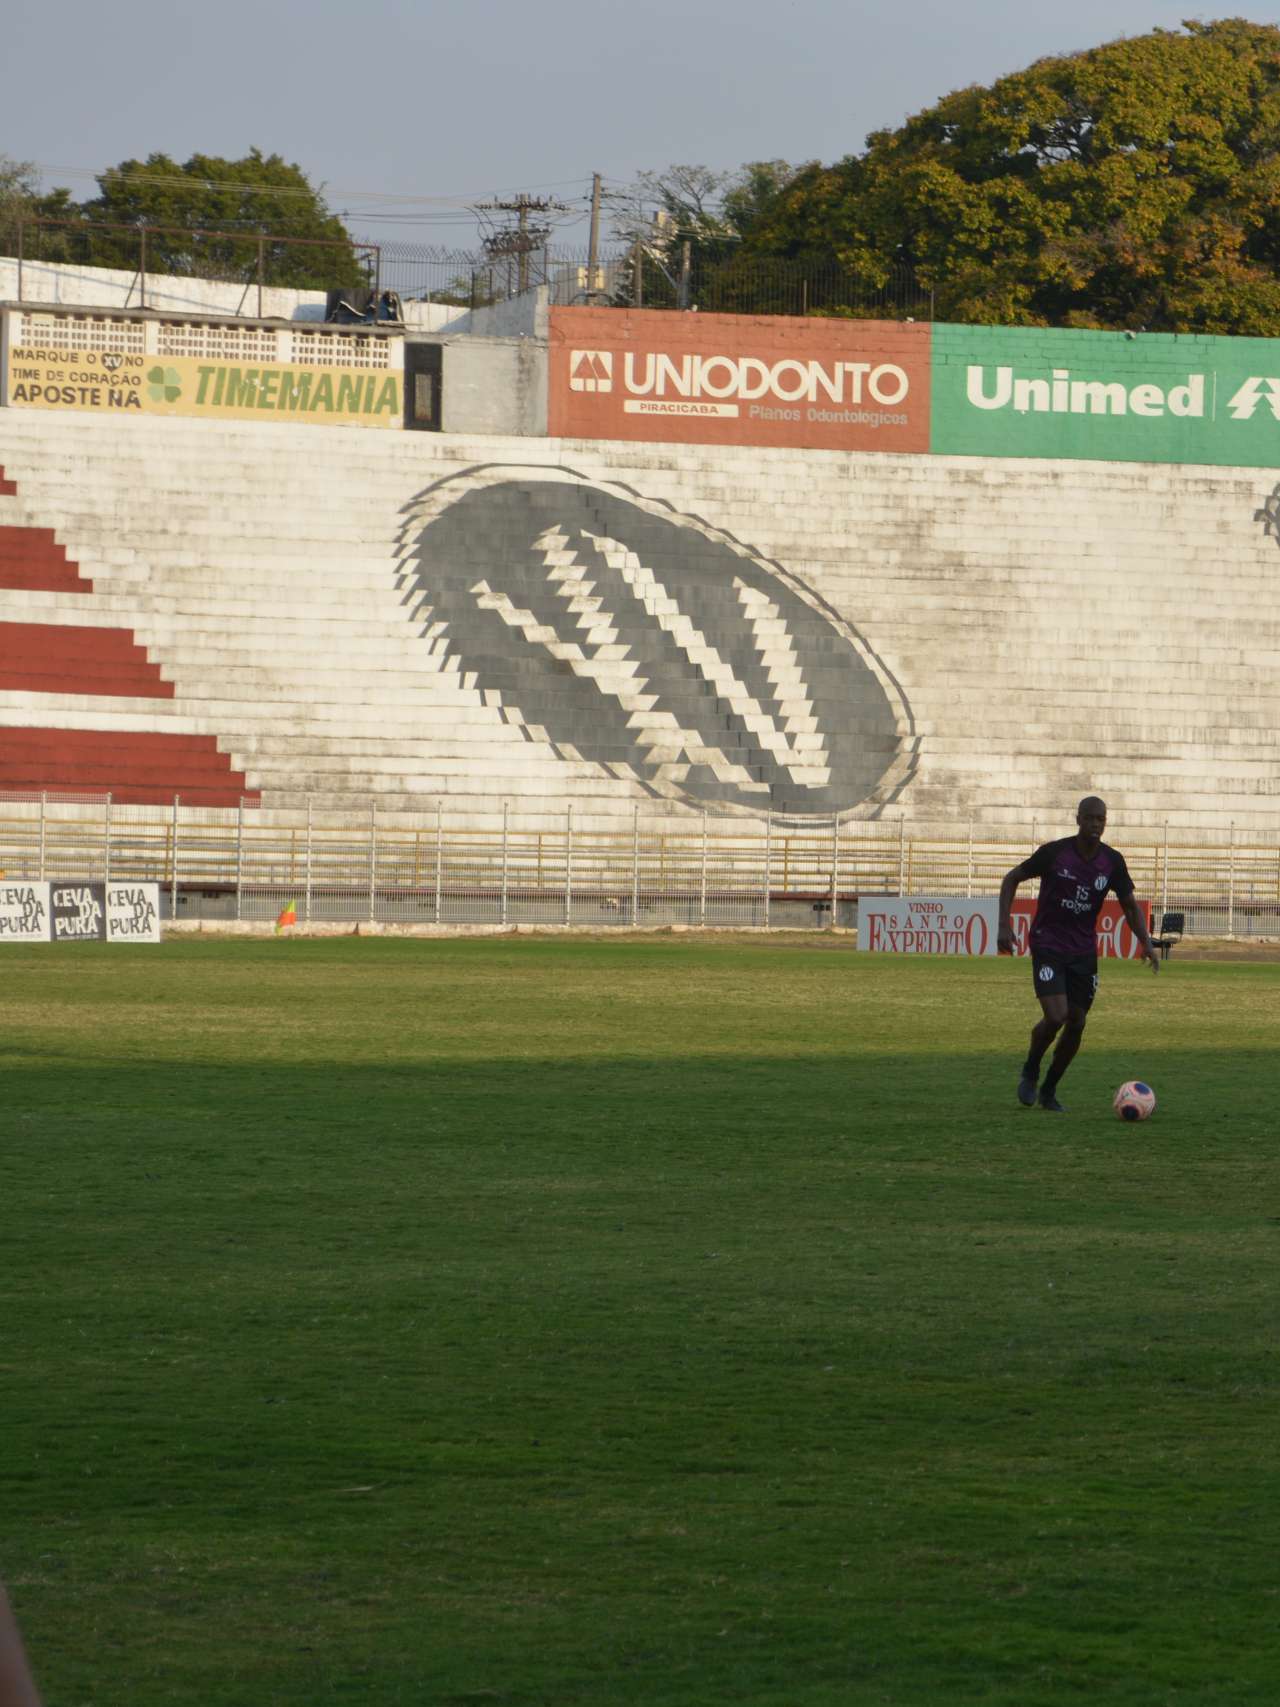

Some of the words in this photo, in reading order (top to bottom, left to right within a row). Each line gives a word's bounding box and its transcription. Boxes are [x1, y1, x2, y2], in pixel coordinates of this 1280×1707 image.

[13, 349, 79, 364] MARQUE
[86, 354, 97, 364] O
[103, 355, 122, 368] XV
[125, 356, 144, 367] NO
[13, 368, 40, 380] TIME
[46, 370, 65, 382] DE
[69, 372, 142, 387] CORAÇÃO
[624, 352, 910, 405] UNIODONTO
[13, 383, 101, 406] APOSTE
[108, 389, 142, 408] NA
[195, 366, 400, 414] TIMEMANIA
[967, 366, 1205, 417] Unimed
[639, 403, 719, 415] PIRACICABA
[749, 405, 801, 422] Planos
[53, 888, 95, 907] CEVA
[108, 889, 147, 907] CEVA
[23, 900, 45, 918] DA
[133, 902, 156, 919] DA
[909, 903, 944, 913] VINHO
[0, 917, 41, 934] PURA
[55, 917, 98, 936] PURA
[110, 918, 152, 935] PURA
[889, 915, 964, 929] SANTO
[867, 913, 988, 955] EXPEDITO
